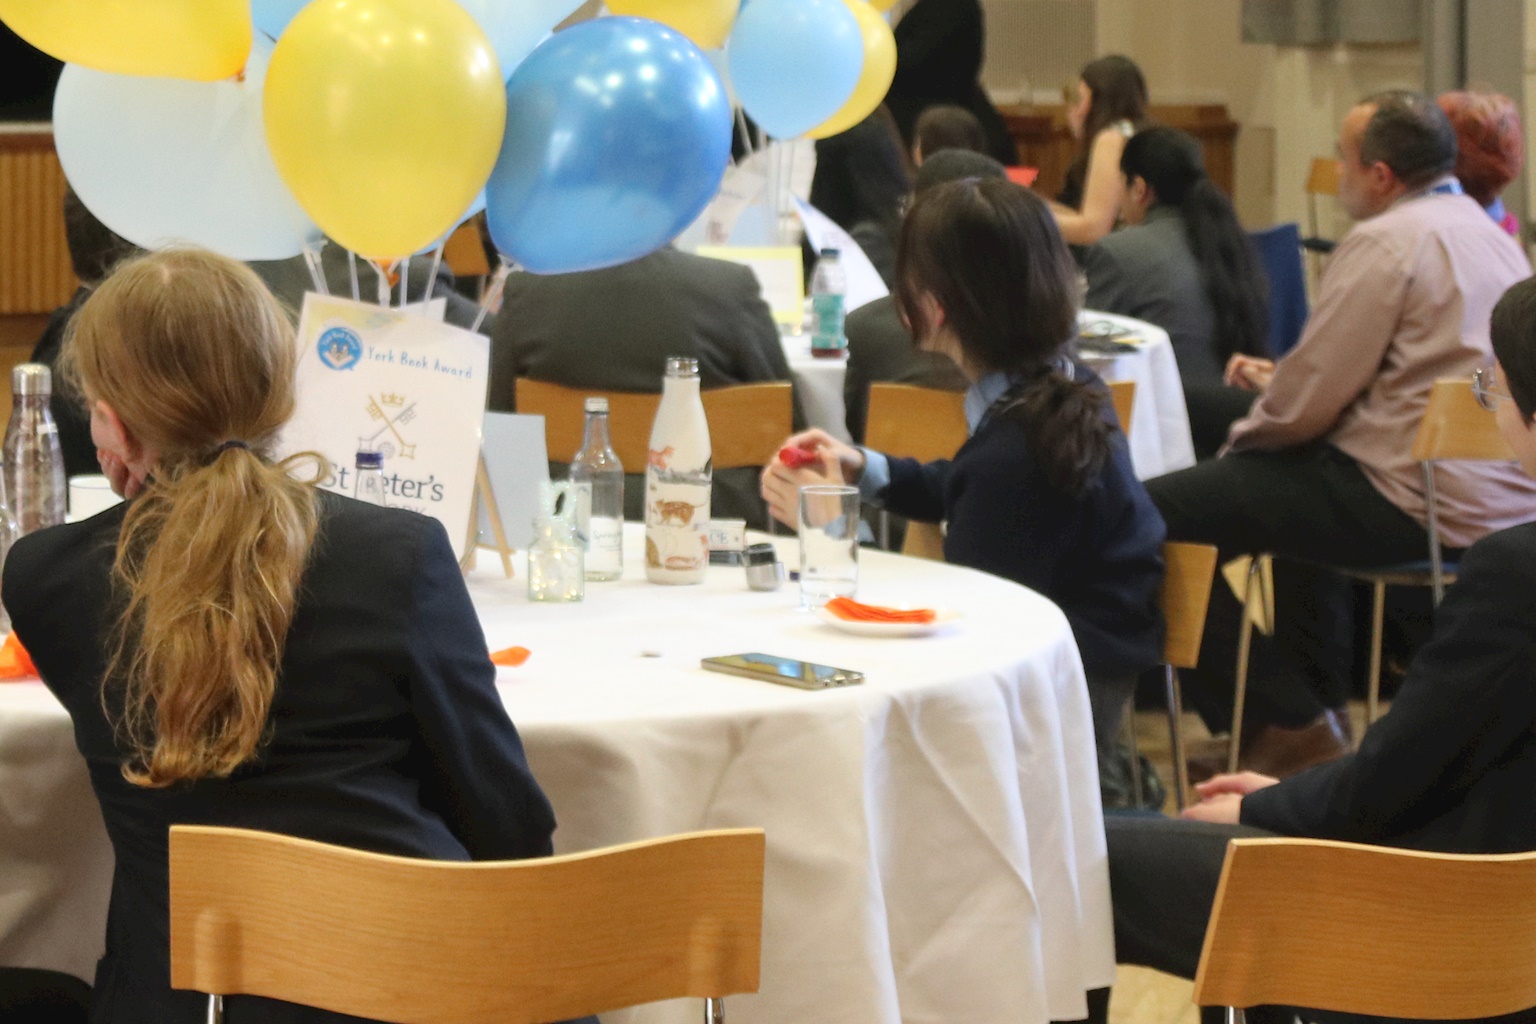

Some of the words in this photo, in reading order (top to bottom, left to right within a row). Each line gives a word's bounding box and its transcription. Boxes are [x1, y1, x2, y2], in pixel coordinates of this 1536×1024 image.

[368, 346, 395, 364] York
[400, 351, 428, 370] Book
[433, 359, 473, 379] Award
[378, 473, 444, 502] eter's
